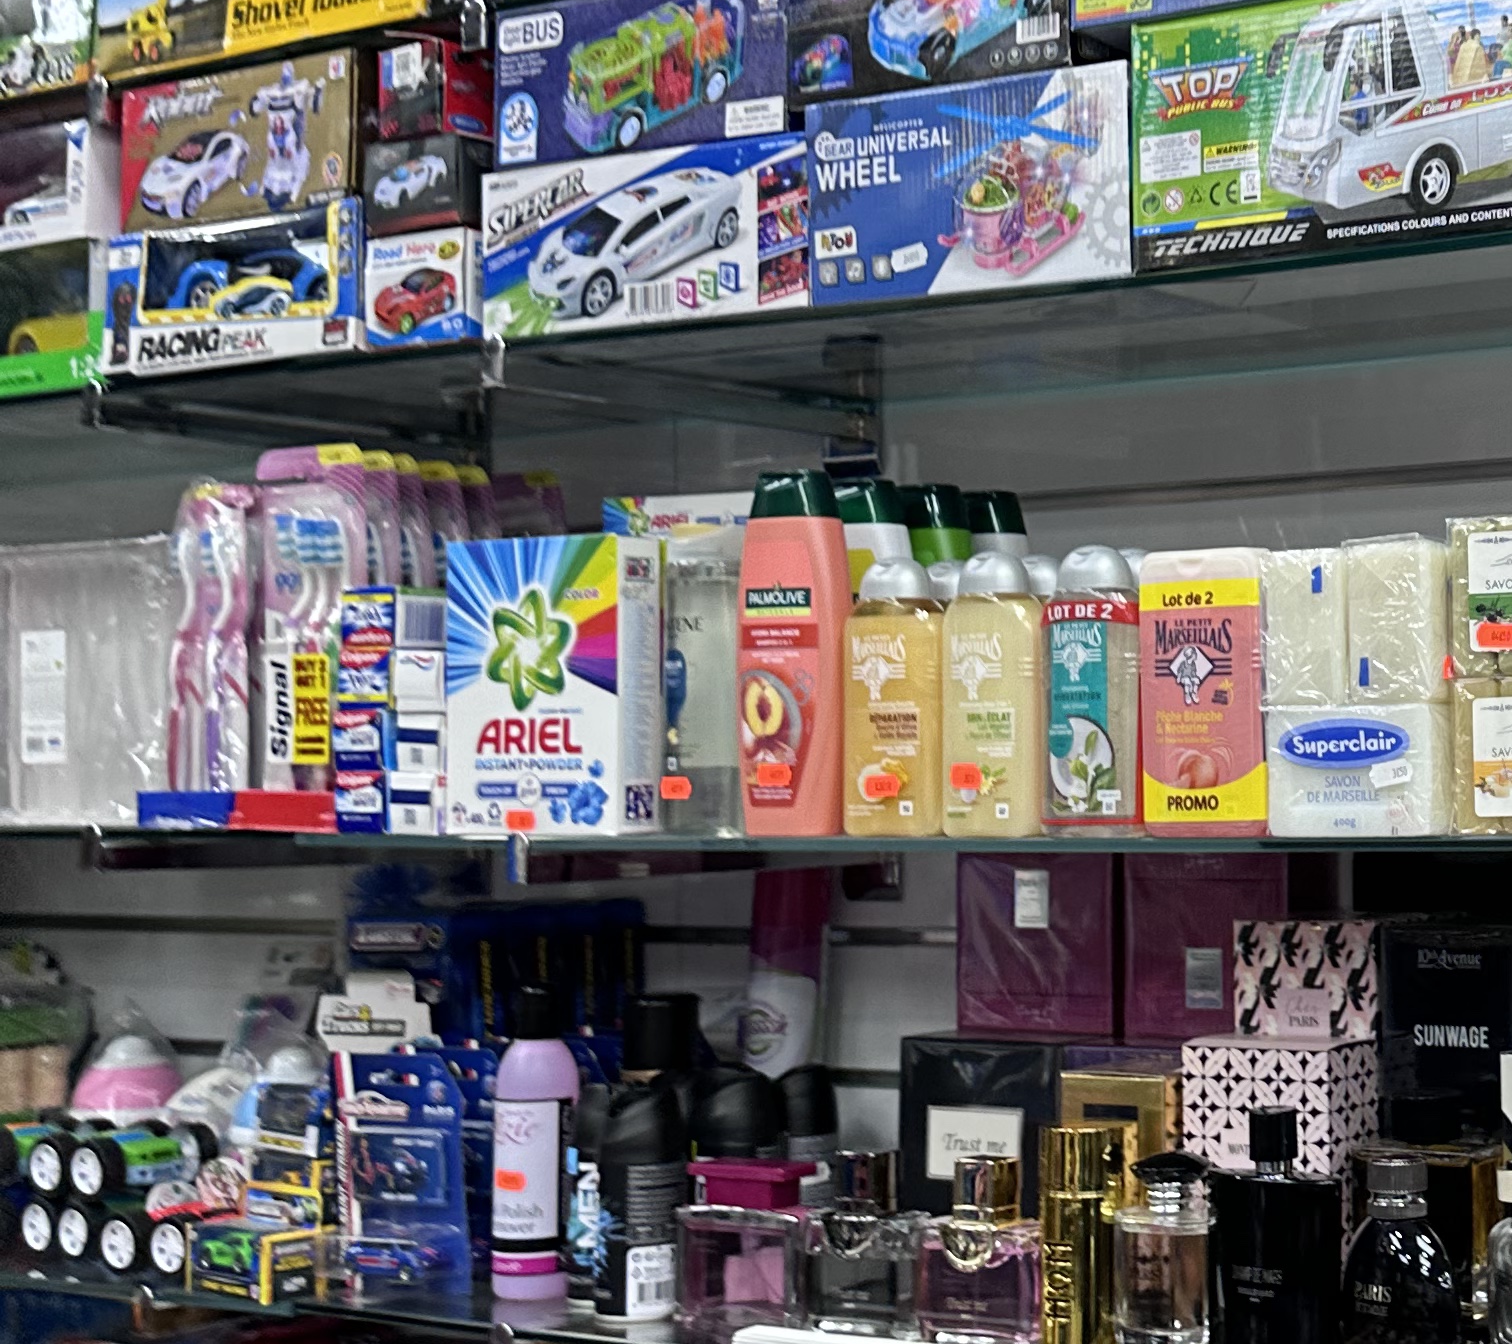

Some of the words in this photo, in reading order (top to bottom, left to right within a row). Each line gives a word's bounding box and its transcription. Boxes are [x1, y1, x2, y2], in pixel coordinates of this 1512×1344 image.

[522, 17, 560, 45] BUS
[1162, 65, 1240, 102] TOP
[1167, 101, 1208, 118] PUBLIC
[1210, 97, 1236, 110] BUS
[873, 117, 924, 132] HELICOPTER
[856, 126, 953, 157] UNIVERSAL
[815, 156, 902, 193] WHEEL
[1326, 219, 1400, 239] SPECIFICATIONS
[1401, 215, 1447, 230] COLOURS
[1449, 212, 1469, 225] AND
[1154, 222, 1311, 258] TECHNIQUE
[137, 326, 221, 363] RACING
[221, 326, 267, 353] PEAK
[650, 514, 690, 530] ARIEL
[563, 587, 601, 601] COLOR
[748, 590, 806, 606] PALMOLIVE
[1162, 593, 1183, 607] Lot
[1184, 591, 1203, 605] de
[1204, 590, 1214, 605] 2
[1047, 604, 1070, 621] LOT
[1075, 603, 1097, 619] DE
[1101, 603, 1113, 619] 2
[1174, 619, 1185, 627] LE
[1186, 618, 1213, 627] PETIT
[1154, 617, 1233, 655] MARSEILLAIS
[270, 660, 292, 759] Signal
[1183, 710, 1224, 723] Blanche
[475, 717, 583, 755] ARIEL
[1292, 729, 1397, 758] Superclair
[1324, 775, 1361, 788] SAVON
[1166, 795, 1220, 812] PROMO
[1306, 791, 1321, 803] DE
[1322, 789, 1381, 803] MARSEILLE
[1333, 817, 1357, 829] 400g
[1287, 1015, 1320, 1028] PARIS
[1413, 1024, 1490, 1049] SUNWAGE
[943, 1133, 983, 1153] Trust
[986, 1140, 1008, 1153] me
[1353, 1281, 1393, 1304] PARIS
